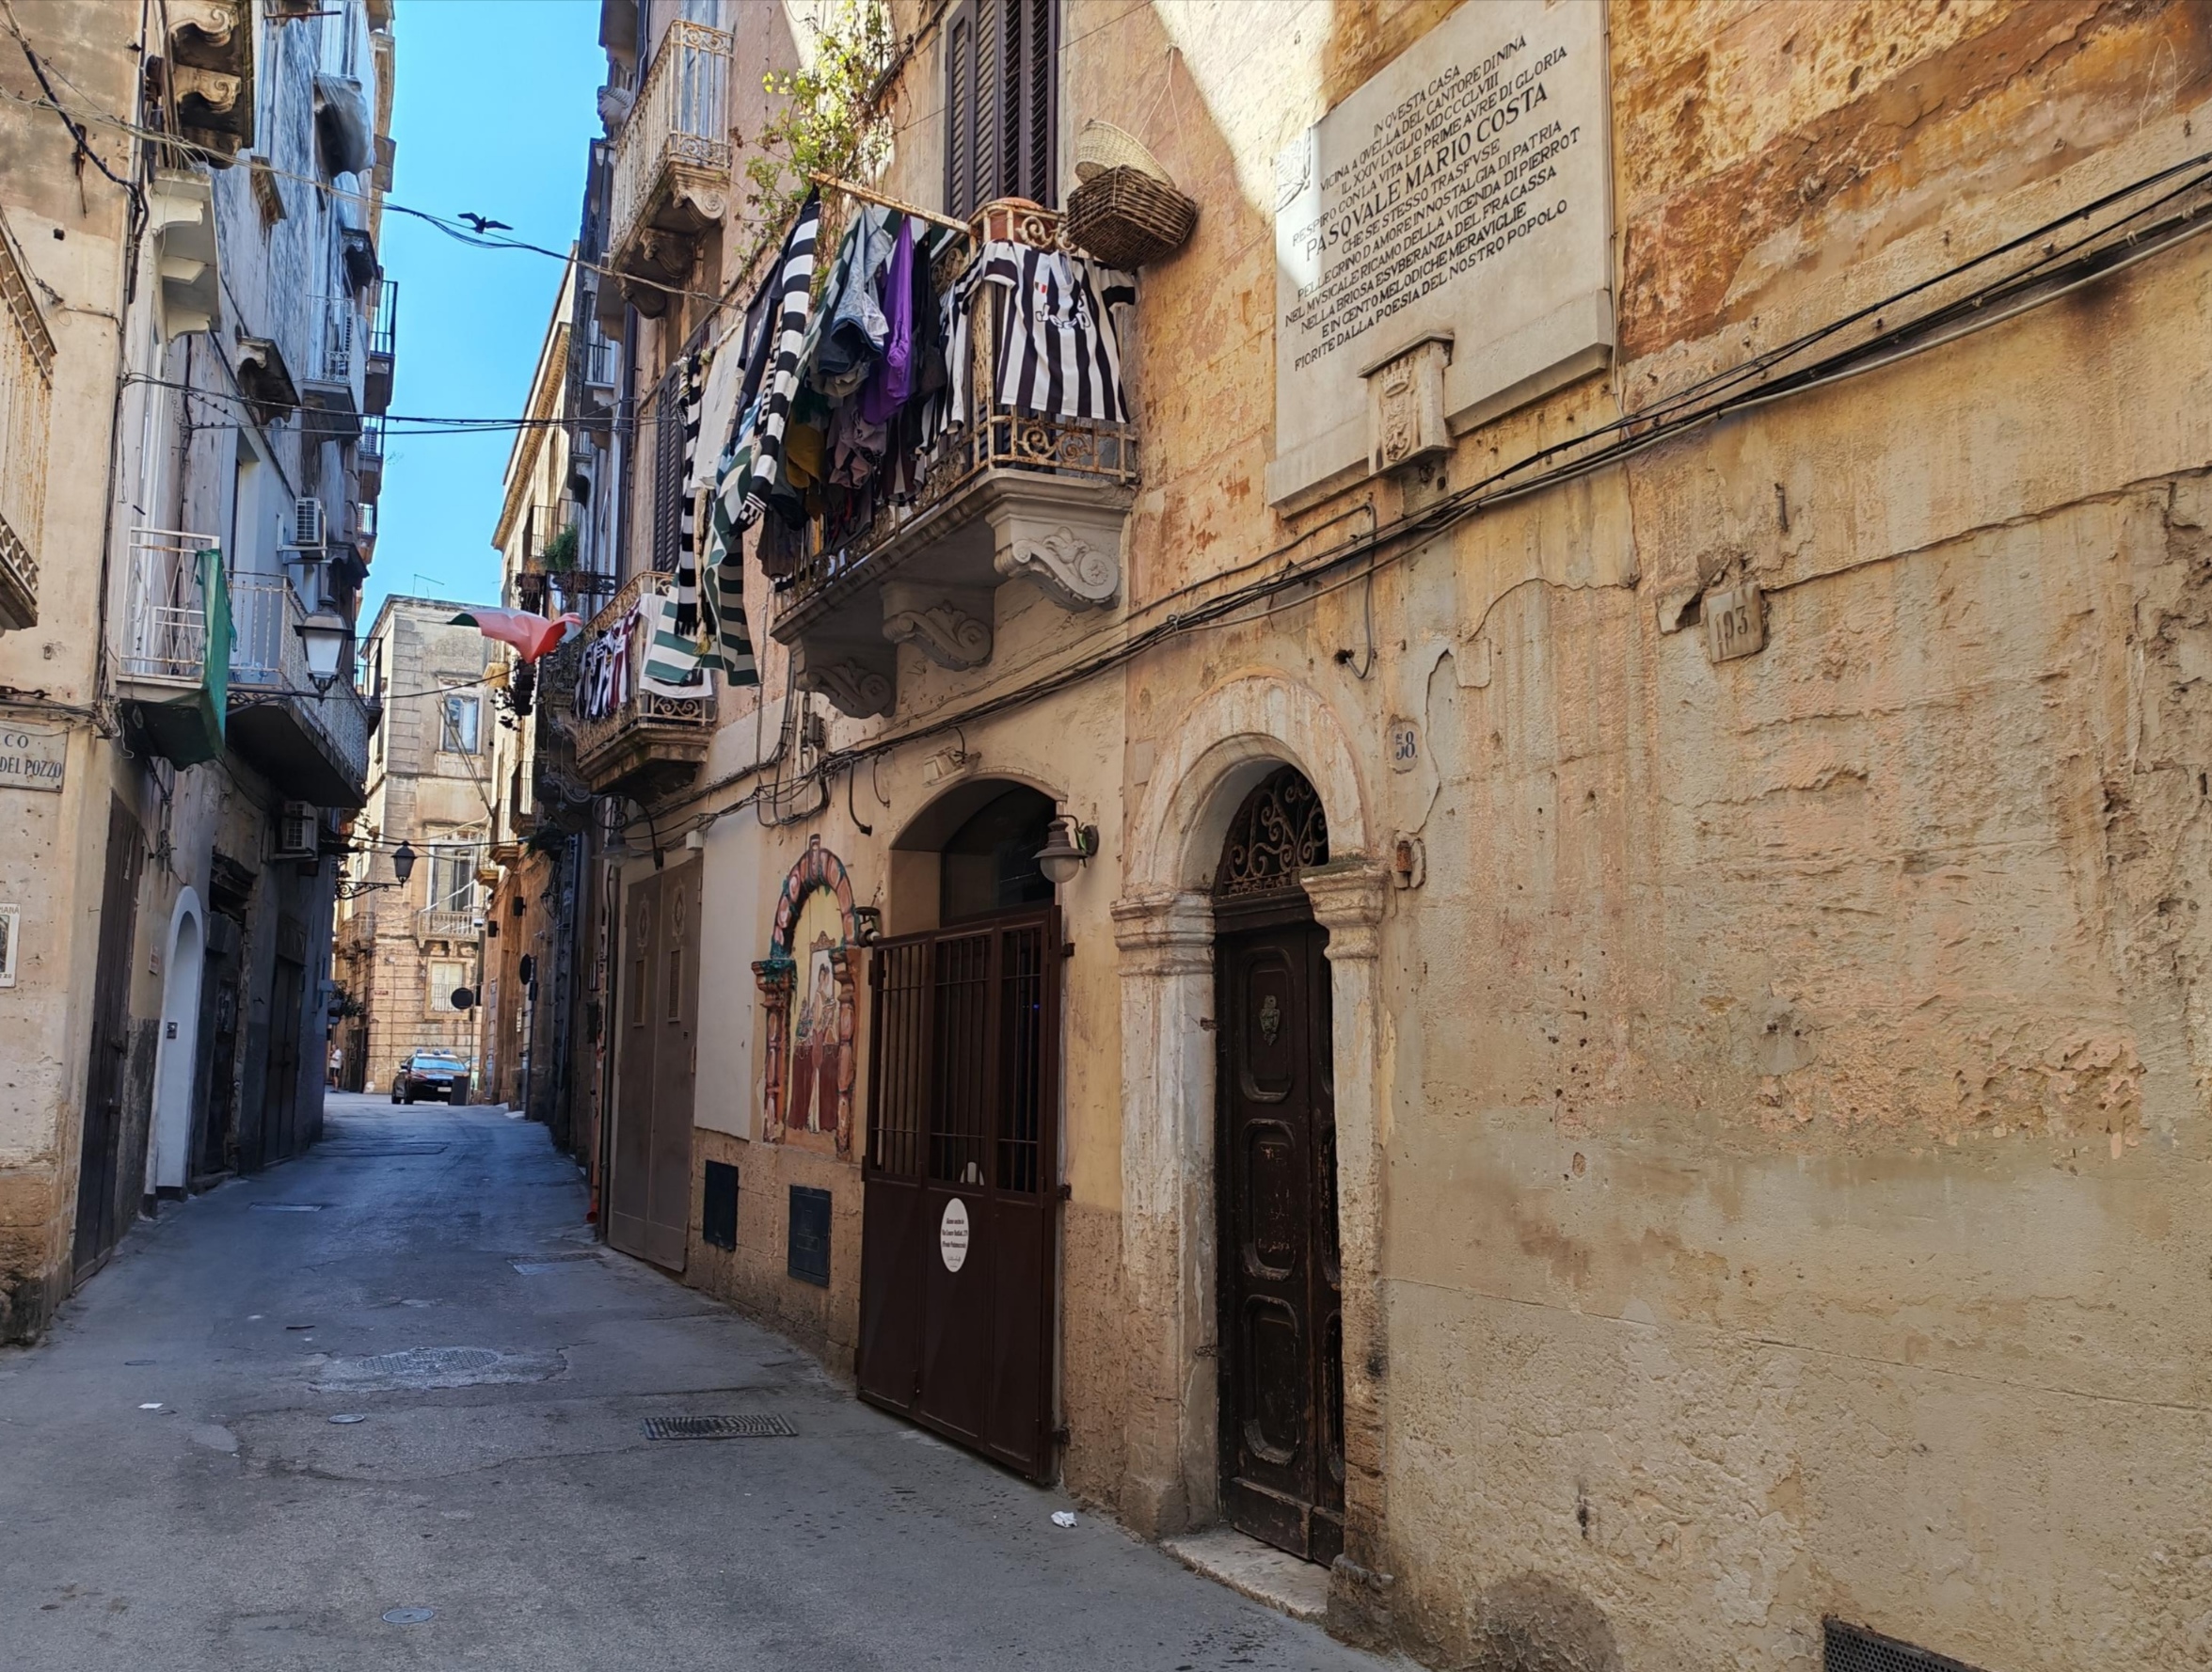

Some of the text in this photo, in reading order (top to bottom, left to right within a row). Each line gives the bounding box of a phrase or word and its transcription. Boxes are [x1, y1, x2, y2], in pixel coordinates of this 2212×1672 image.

[1293, 46, 1567, 247] RESPIRO CON LA VITA LE PRIME AVRE DI GLORIA
[1307, 82, 1548, 262] PASQVALE MARIO COSTA
[1320, 165, 1349, 191] VICINA
[1360, 128, 1401, 165] QVELLA
[1402, 109, 1424, 135] DEL
[1426, 65, 1481, 116] CANTORE
[1483, 55, 1496, 76] DI
[1497, 34, 1526, 66] NINA
[1342, 71, 1499, 195] IL XXIV LVGLIO MDCCCLVIII
[1374, 64, 1460, 137] IN QVESTA CASA
[1285, 126, 1580, 327] NEL MVSICALE RICAMO DELLA VICENDA DI PIERROT
[1297, 251, 1361, 302] PELLEGRINO
[1373, 216, 1412, 253] AMORE
[1413, 207, 1425, 226] IN
[1426, 164, 1496, 217] NOSTALGIA
[1498, 151, 1511, 170] DI
[1512, 119, 1562, 162] PATRIA
[1301, 165, 1557, 335] NELLA BRIOSA ESVBERANZA DEL FRACASSA
[1330, 316, 1341, 333] IN
[1342, 294, 1378, 325] CENTO
[1379, 249, 1448, 304] MELODICHE
[1449, 201, 1527, 262] MERAVIGLIE
[1342, 138, 1500, 254] CHE SE STESSO TRASFVSE
[1295, 199, 1567, 372] FIORITE DALLA POESIA DEL NOSTRO POPOLO
[0, 756, 63, 779] DEL POZZO
